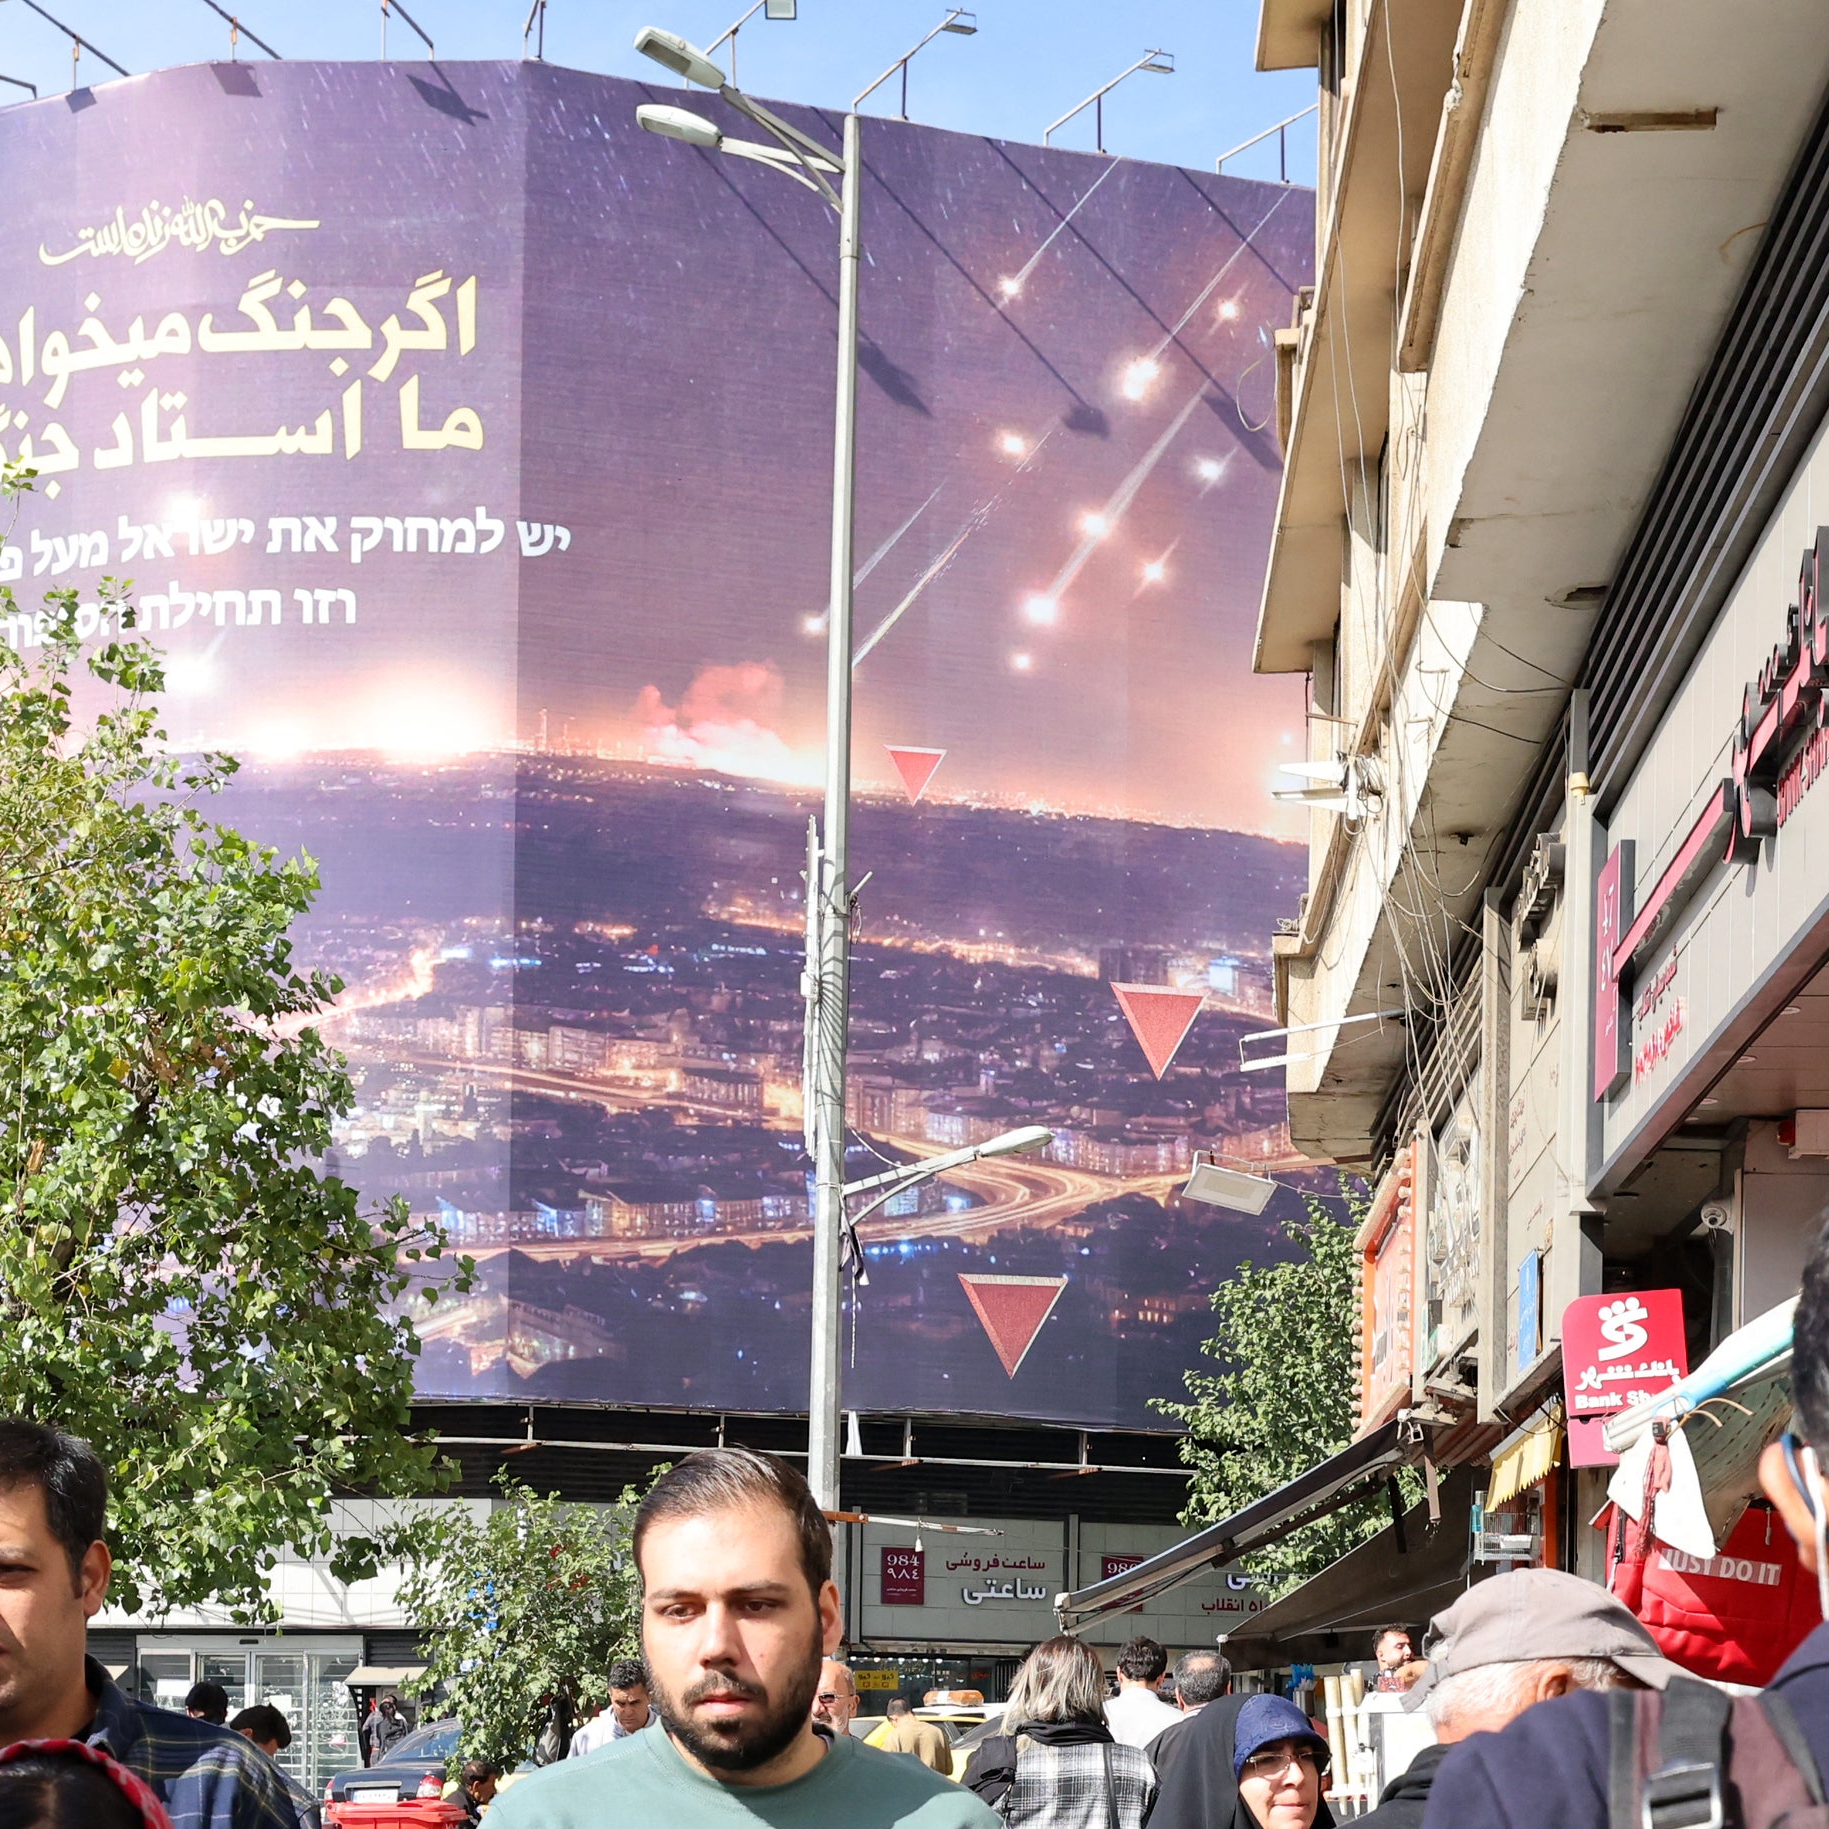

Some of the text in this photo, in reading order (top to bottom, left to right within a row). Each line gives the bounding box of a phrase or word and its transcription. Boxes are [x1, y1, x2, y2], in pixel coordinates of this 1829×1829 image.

[198, 269, 372, 377] جنگ
[368, 269, 476, 382] اگر
[94, 378, 362, 469] استاد
[399, 374, 484, 451] ما
[31, 528, 109, 577] מעל
[118, 515, 255, 562] ישראל
[266, 516, 339, 554] את
[350, 506, 505, 564] למחוק
[516, 521, 572, 557] יש
[138, 581, 282, 632] תחילת
[294, 588, 357, 625] וזו
[1575, 1390, 1654, 1410] Bank Sh
[886, 1553, 921, 1568] 984
[1003, 1555, 1047, 1570] ساعت
[1720, 1557, 1753, 1581] DO
[1758, 1562, 1780, 1585] IT
[962, 1578, 1047, 1606] ساعتی
[1201, 1598, 1244, 1615] انقلاب
